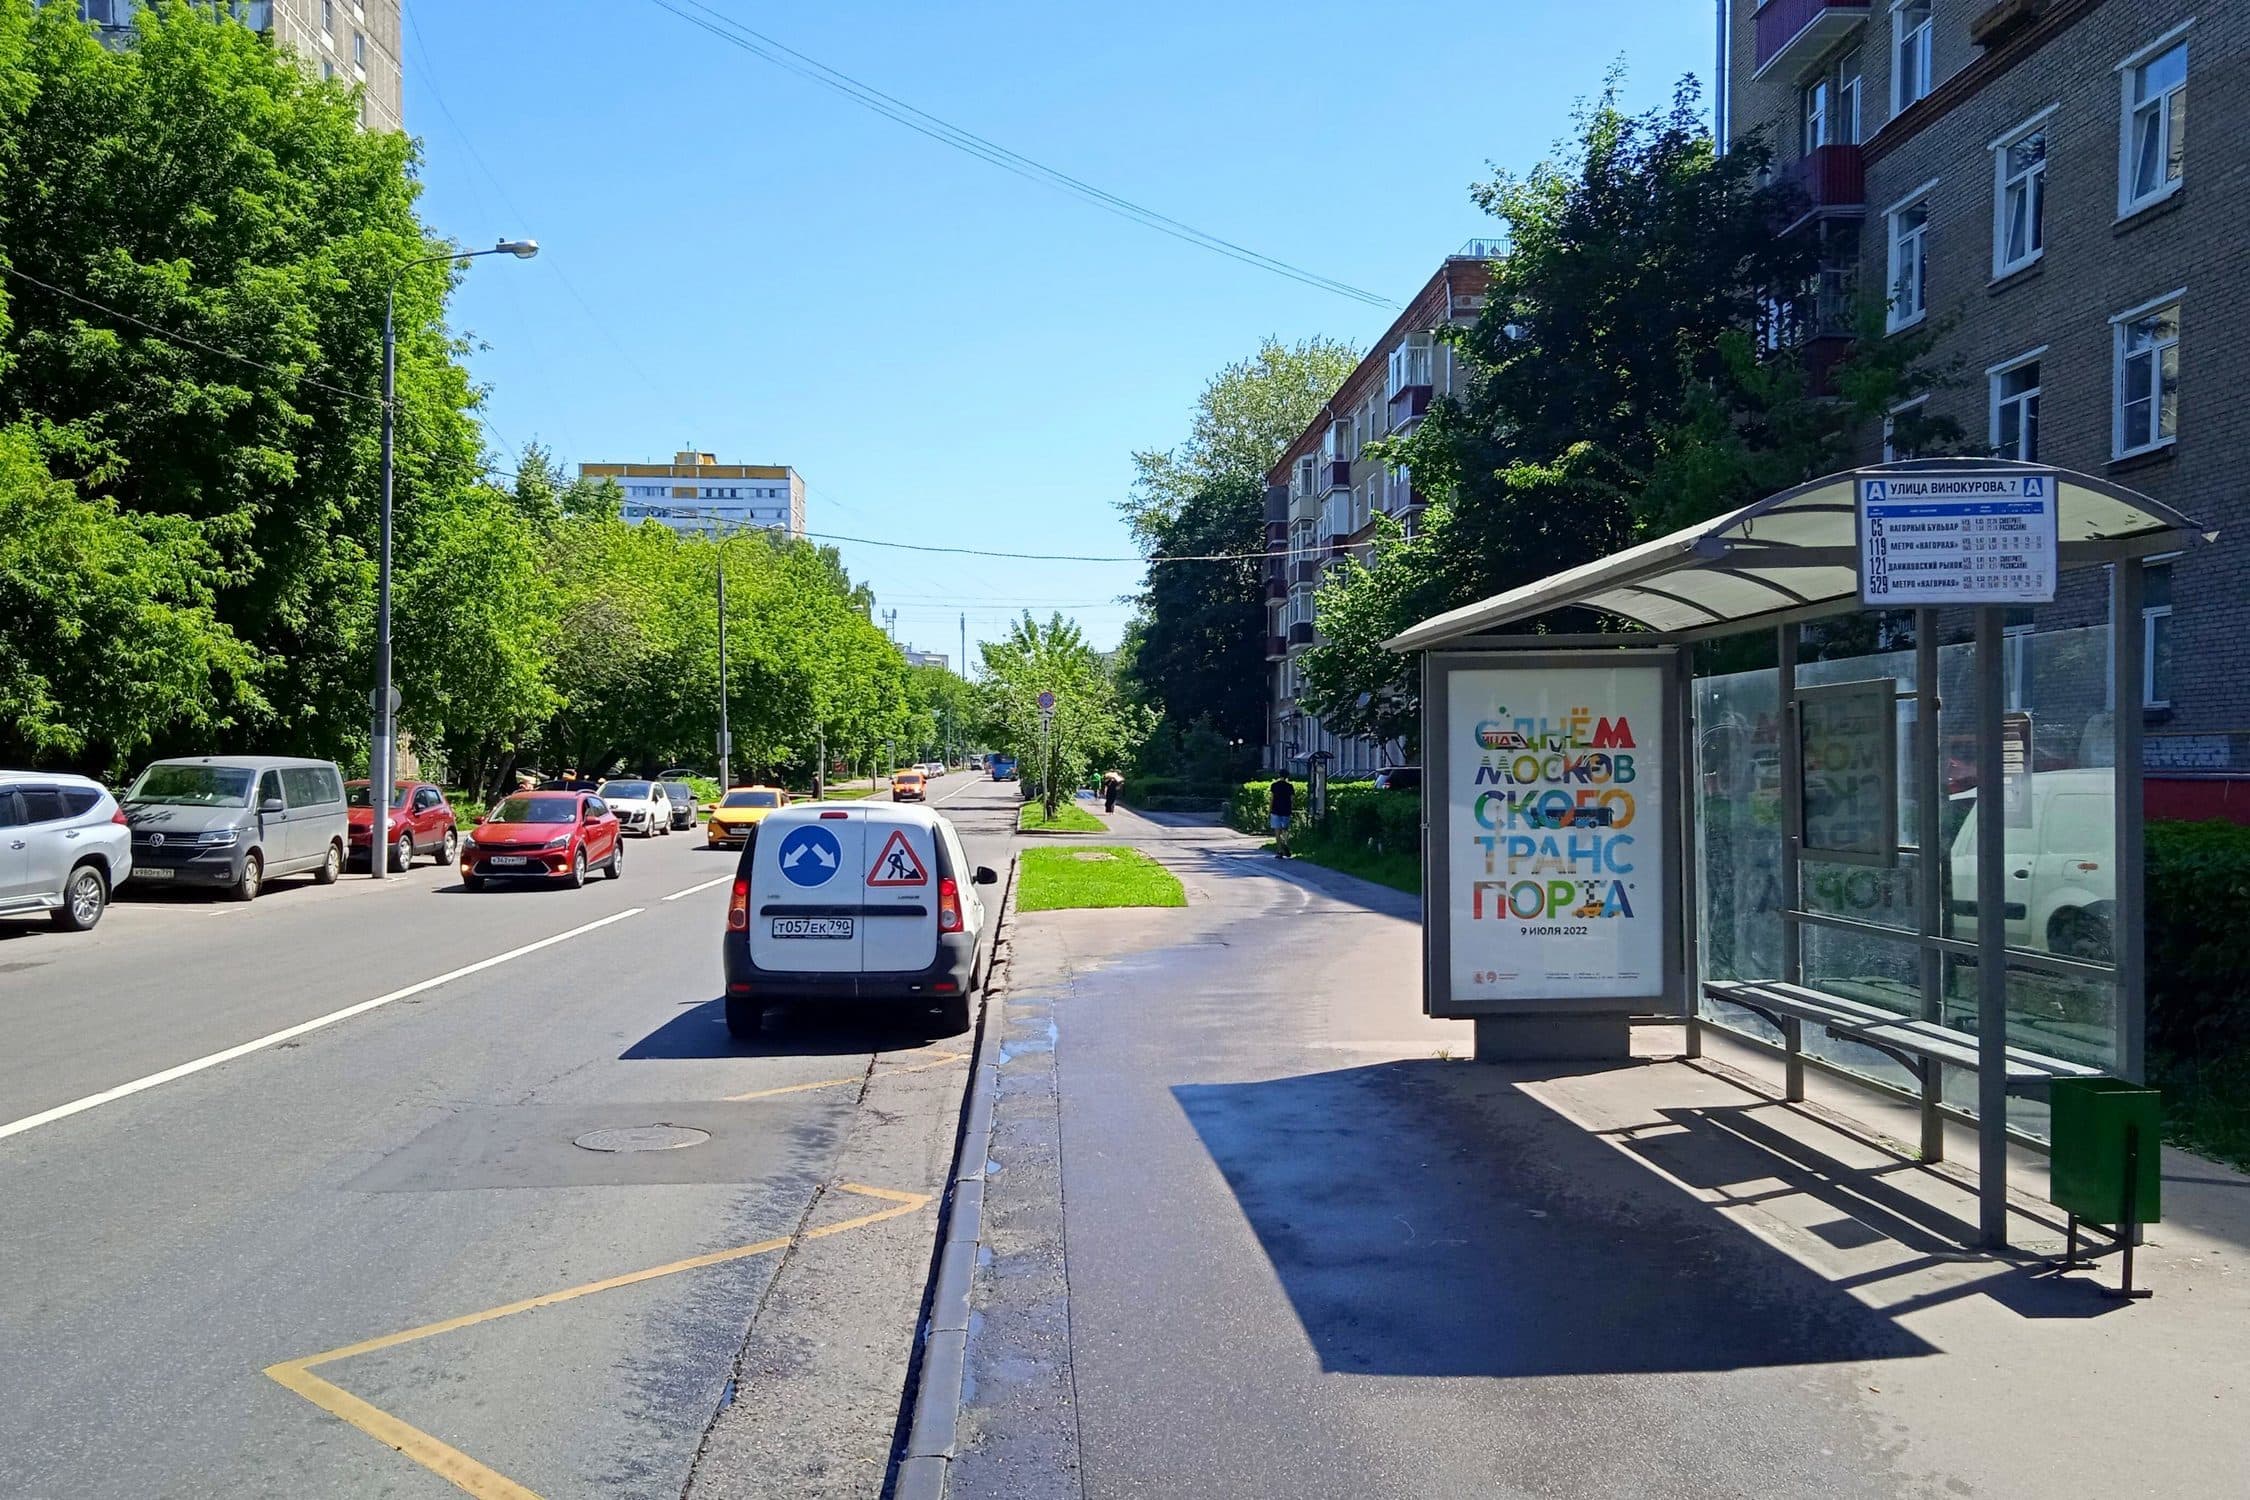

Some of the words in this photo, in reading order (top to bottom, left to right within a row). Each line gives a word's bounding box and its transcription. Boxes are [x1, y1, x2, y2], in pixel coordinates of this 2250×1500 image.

[1890, 483, 1928, 496] УЛИЦА
[1931, 481, 2007, 494] ВИНОКУРОВА,
[2009, 480, 2017, 492] 7
[1889, 524, 1926, 532] НАГОРНЫЙ
[1927, 523, 1959, 532] БУЛЬВАР
[1869, 537, 1887, 556] 119
[1890, 542, 1914, 550] МЕТРО
[1869, 556, 1887, 575] 121
[1938, 561, 1963, 570] РЫНОК
[1870, 575, 1889, 594] 529
[1892, 580, 1916, 589] МЕТРО
[1513, 706, 1636, 752] ДНЁМ
[1474, 753, 1636, 785] МОСКОВ
[1474, 788, 1636, 830] СКОГО
[1473, 834, 1635, 875] ТРАНС
[1473, 879, 1635, 920] ПОРТА
[829, 920, 849, 930] 790
[1520, 926, 1527, 936] 9
[1529, 926, 1561, 936] ИЮЛЯ
[1563, 926, 1588, 935] 2022
